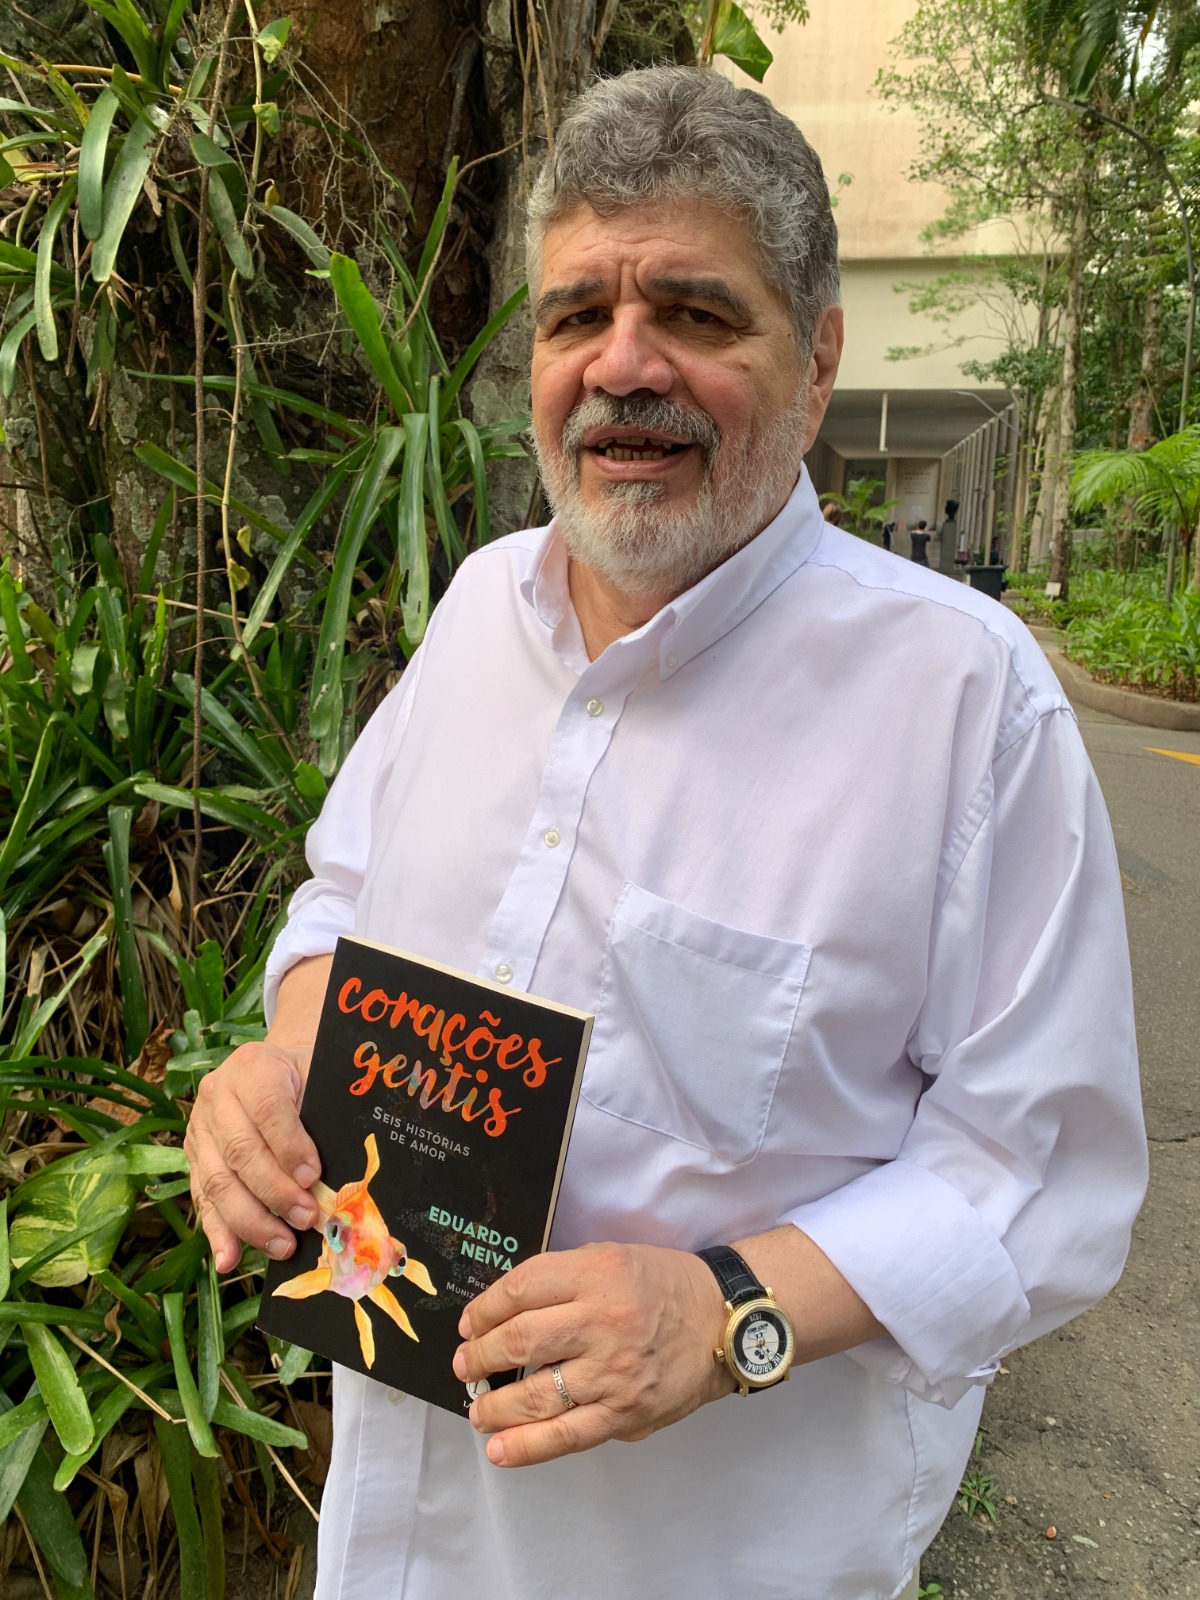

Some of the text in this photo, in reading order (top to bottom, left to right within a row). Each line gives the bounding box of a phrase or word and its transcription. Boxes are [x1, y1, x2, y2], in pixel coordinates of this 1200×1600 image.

[338, 977, 562, 1088] corações
[349, 1041, 522, 1137] gentis
[390, 1130, 446, 1162] DE AMOR
[428, 1205, 519, 1253] EDUARDO
[460, 1239, 513, 1272] NEIVA
[745, 1353, 784, 1374] THE ORIGINAL
